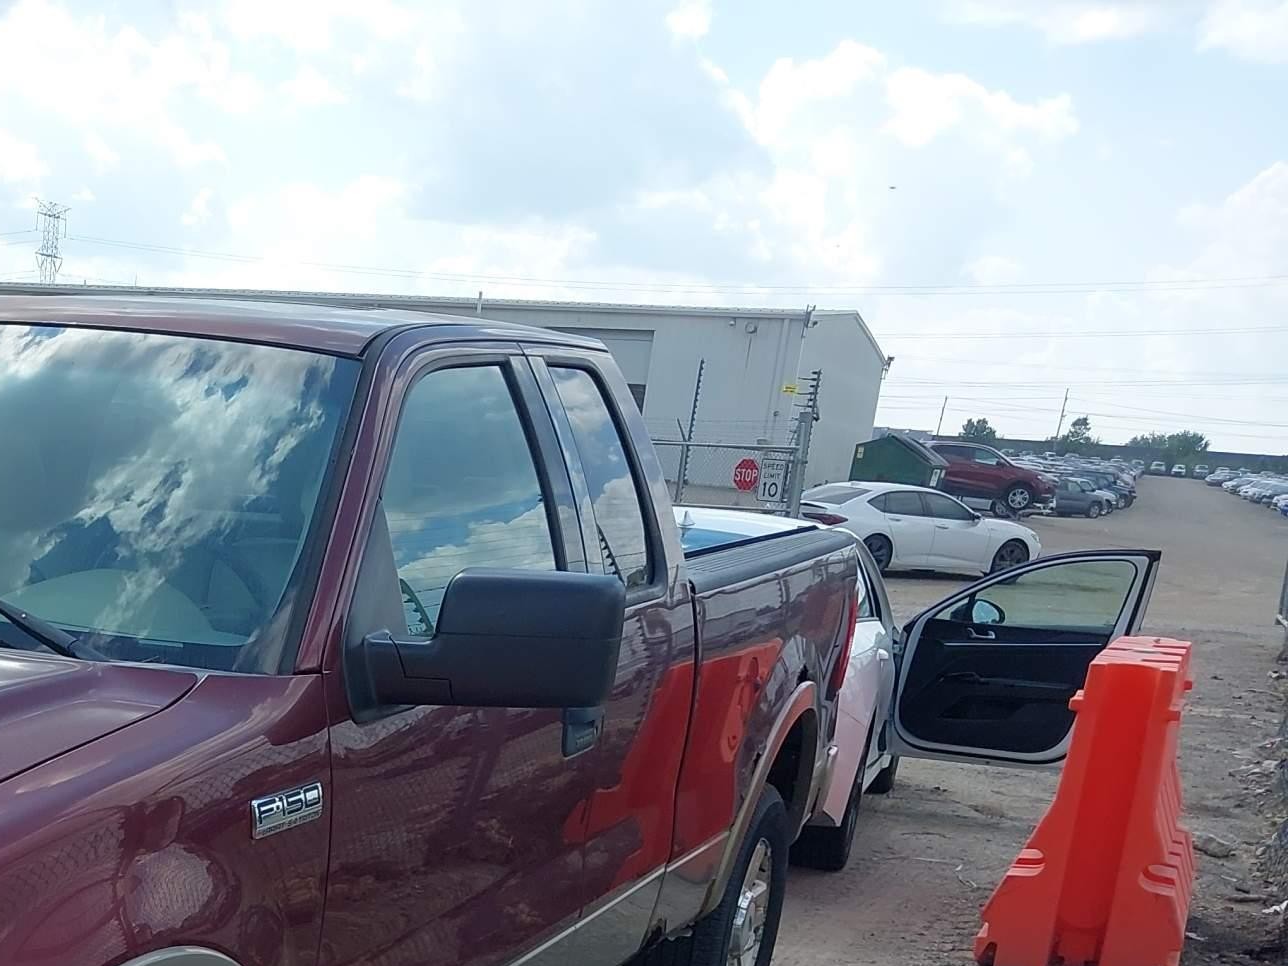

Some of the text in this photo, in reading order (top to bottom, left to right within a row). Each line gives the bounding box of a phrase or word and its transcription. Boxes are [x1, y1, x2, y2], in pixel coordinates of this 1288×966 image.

[762, 463, 785, 472] SPEED
[734, 468, 758, 482] STOP
[762, 482, 778, 497] 10
